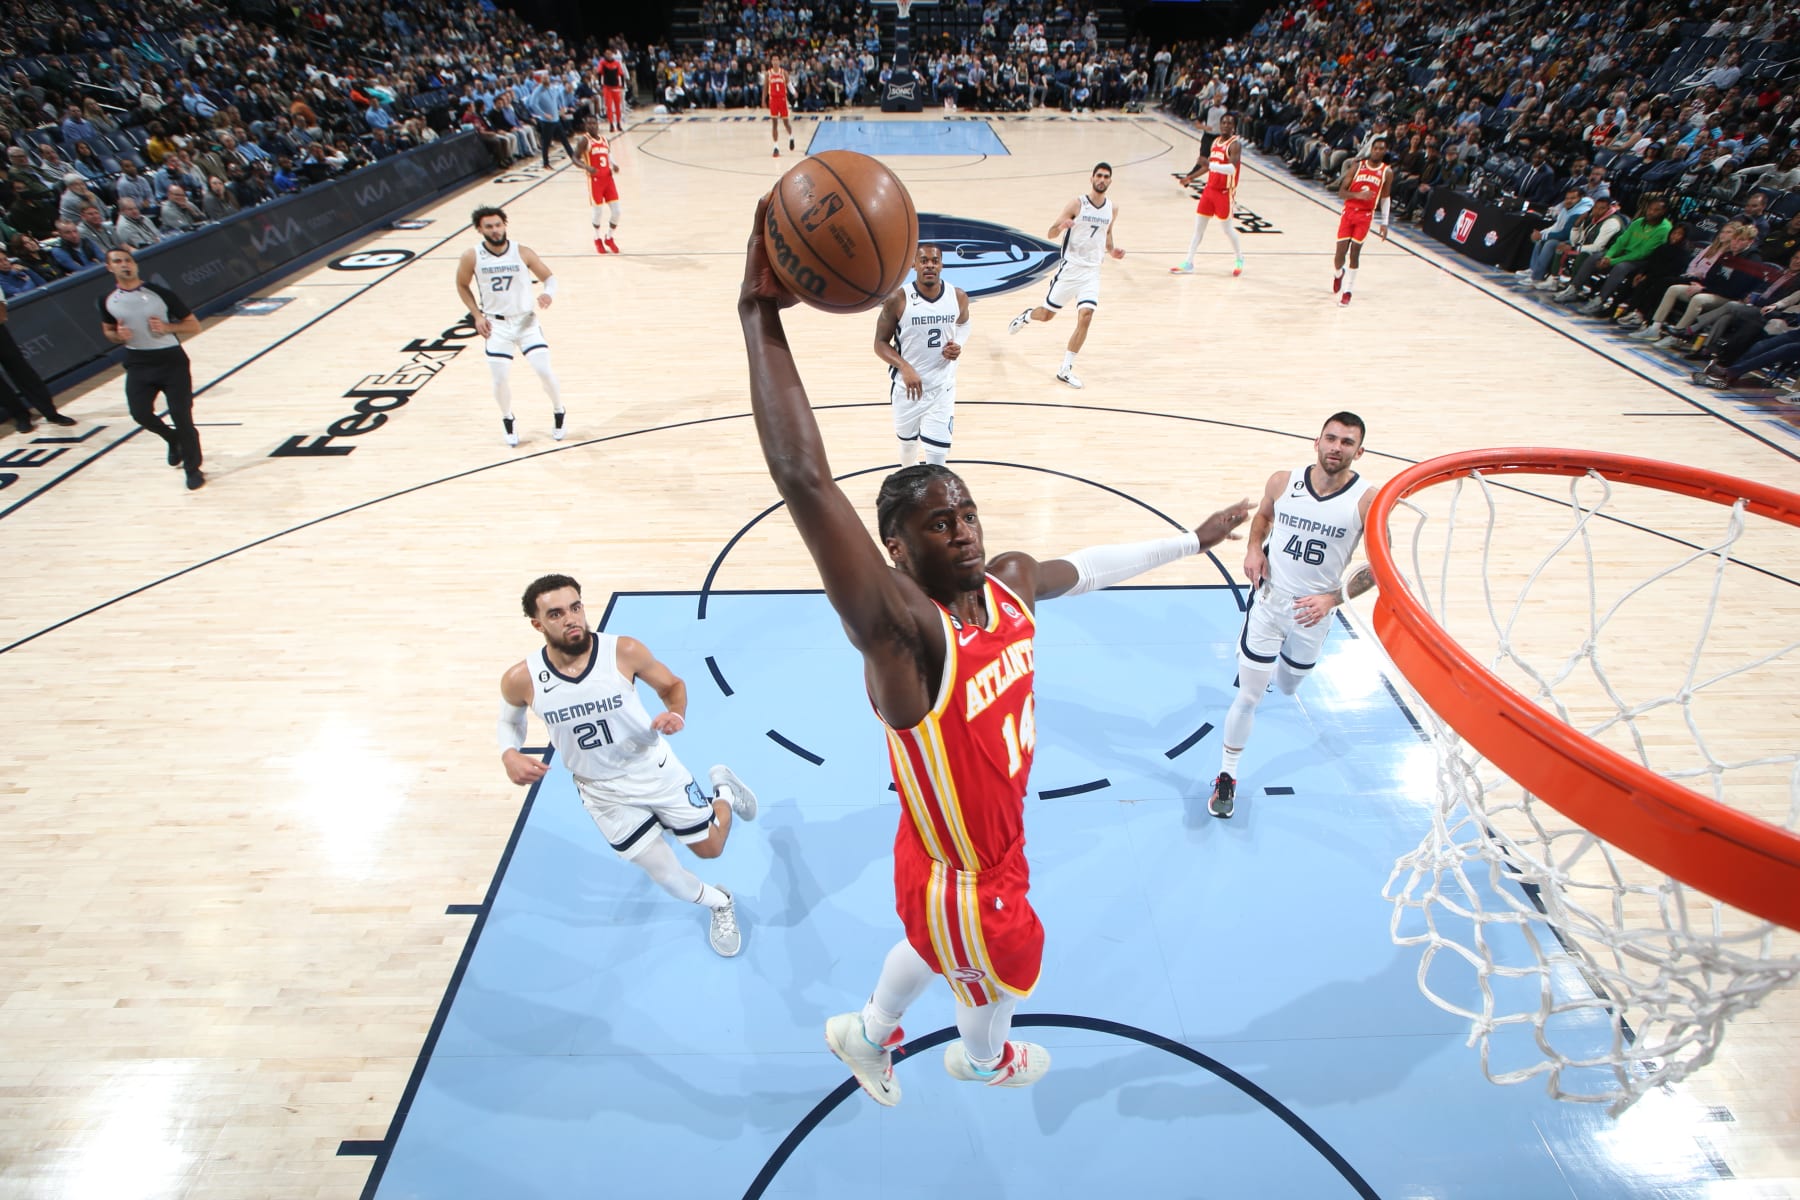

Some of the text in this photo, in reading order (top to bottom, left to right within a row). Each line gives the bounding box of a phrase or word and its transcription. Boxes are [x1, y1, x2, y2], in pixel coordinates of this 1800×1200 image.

[891, 87, 912, 95] SONIC
[600, 156, 607, 167] 3
[1090, 225, 1099, 238] 7
[481, 265, 520, 274] MEMPHIS
[491, 276, 513, 292] 27
[911, 315, 955, 326] MEMPHIS
[928, 328, 941, 348] 2
[1279, 512, 1347, 539] MEMPHIS
[1283, 534, 1327, 566] 46
[965, 638, 1034, 722] ATLANT
[544, 694, 623, 725] MEMPHIS
[573, 718, 614, 751] 21
[1001, 691, 1036, 779] 14
